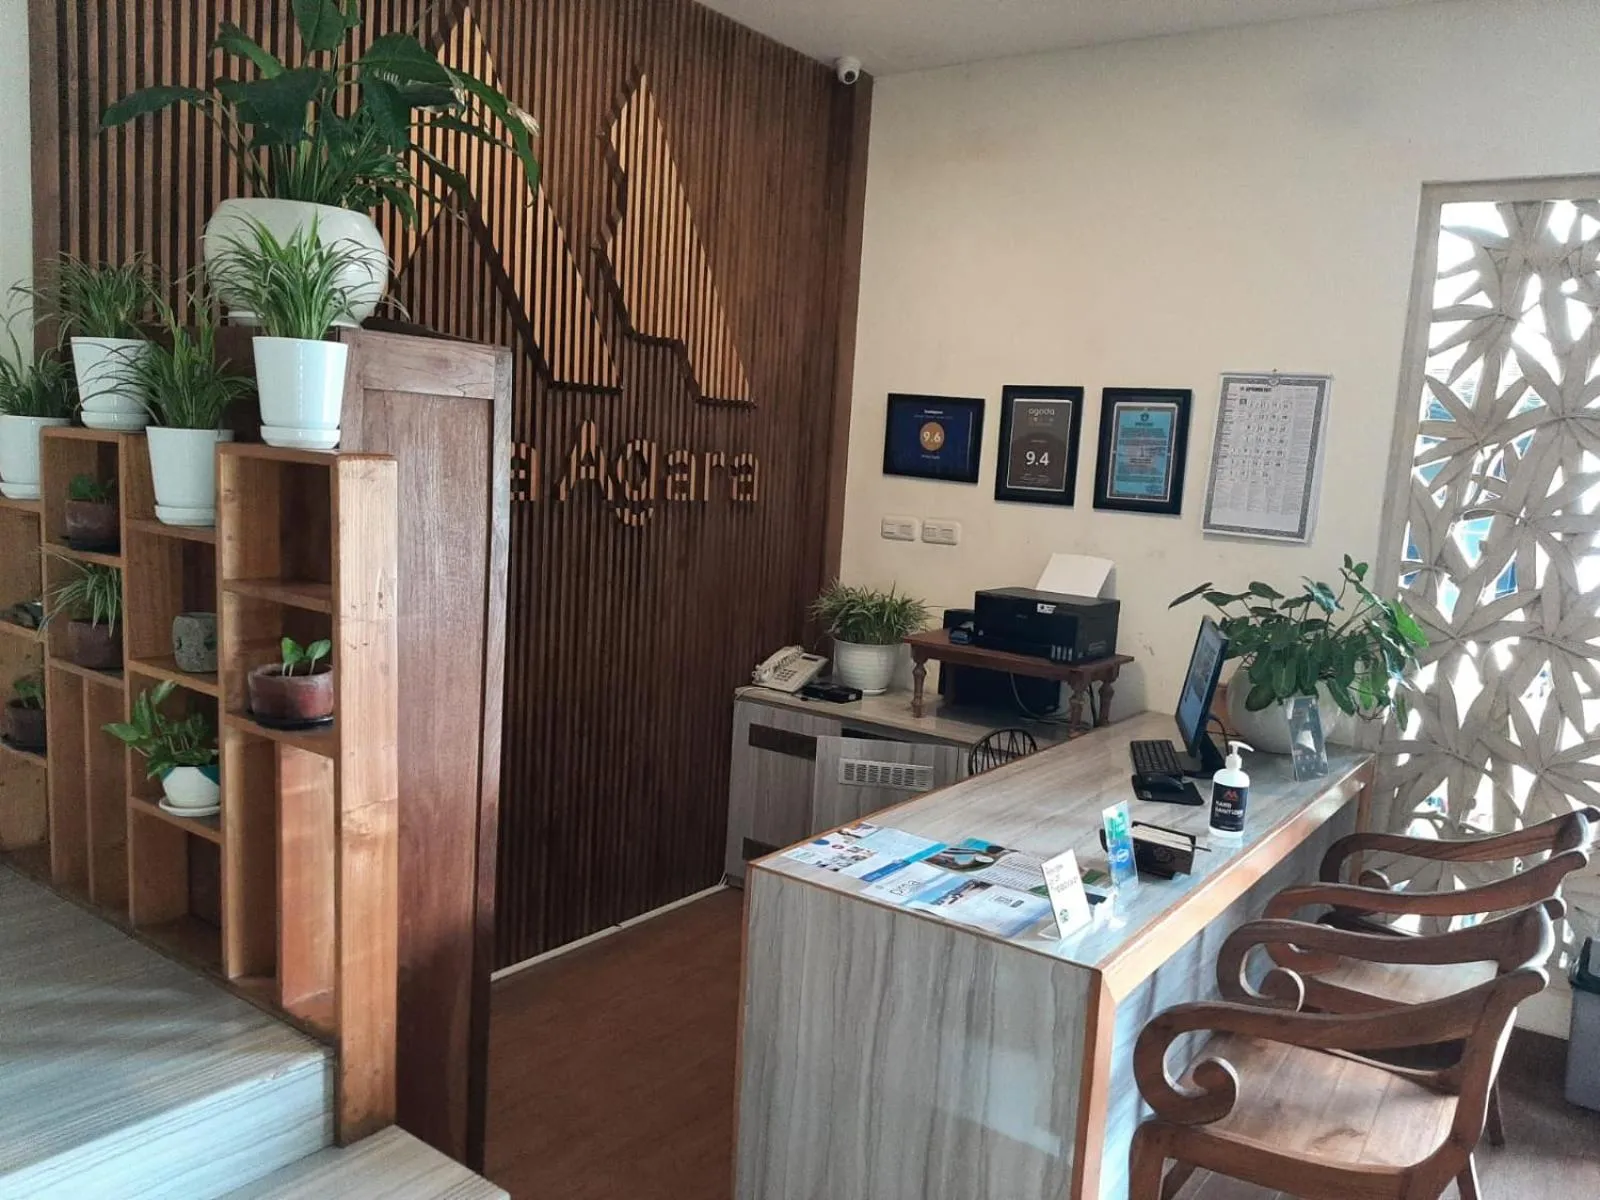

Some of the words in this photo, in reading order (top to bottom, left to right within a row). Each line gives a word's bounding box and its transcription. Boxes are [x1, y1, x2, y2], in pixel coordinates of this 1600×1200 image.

[923, 431, 941, 443] 9.6
[1026, 450, 1050, 466] 9.4
[559, 420, 759, 527] Agara
